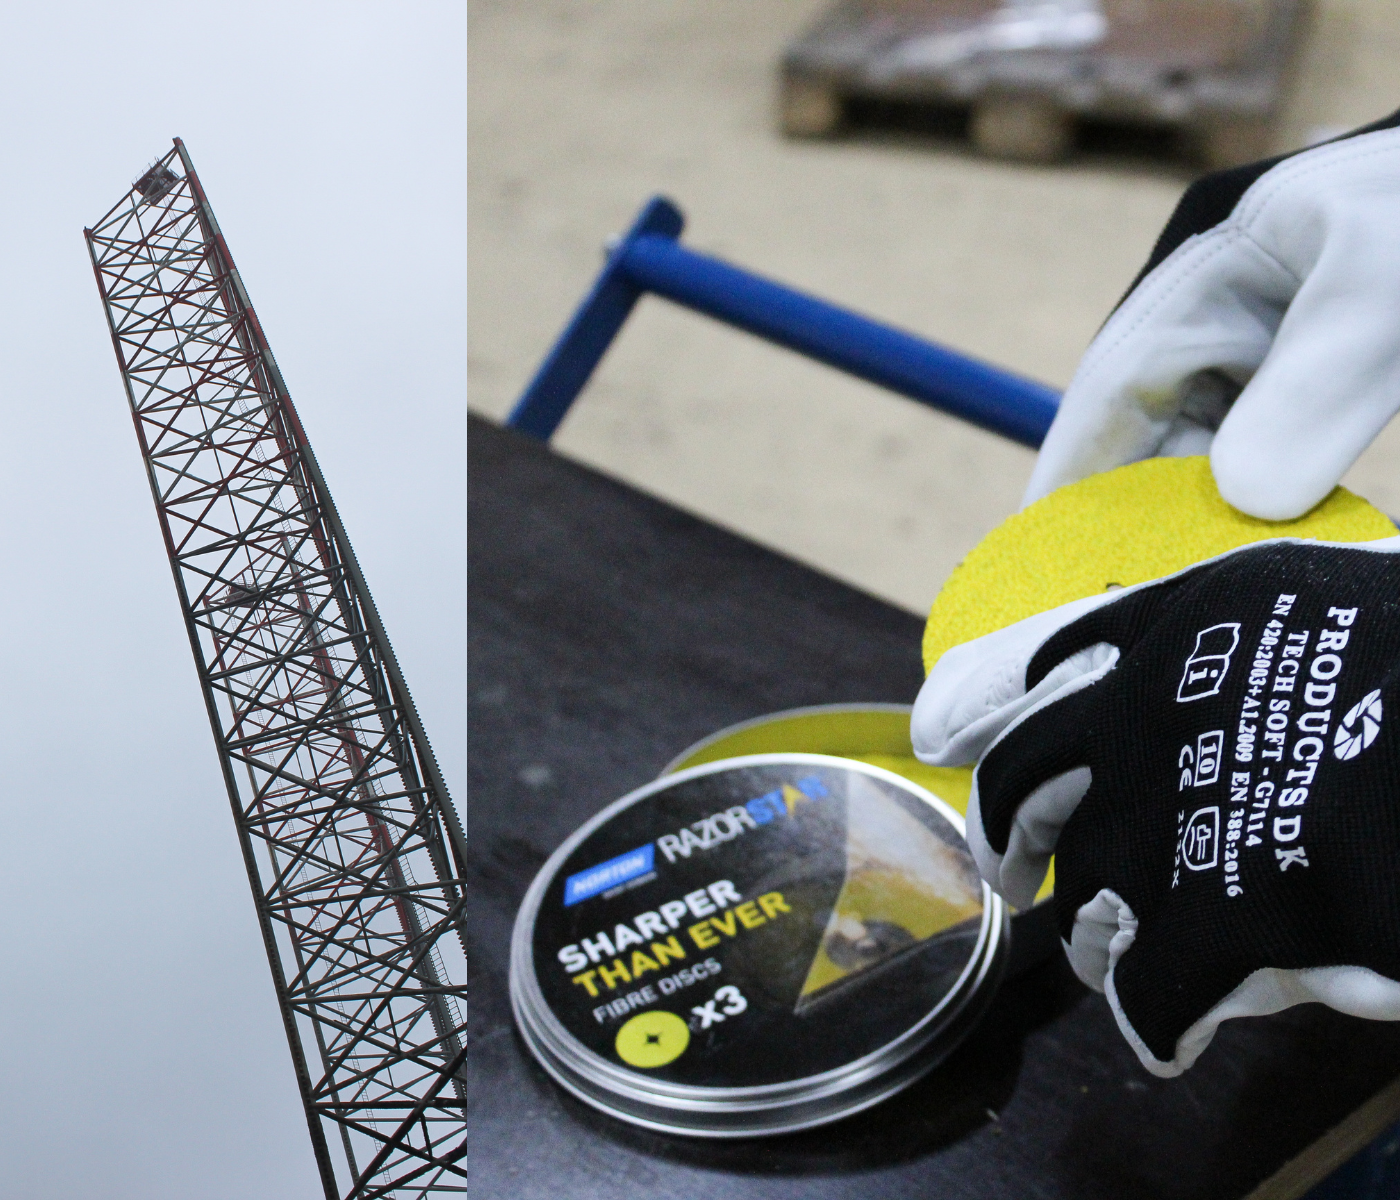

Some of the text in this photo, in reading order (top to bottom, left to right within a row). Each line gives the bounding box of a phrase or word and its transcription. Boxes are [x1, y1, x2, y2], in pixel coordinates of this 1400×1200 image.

[1273, 631, 1310, 693] TECH
[1200, 742, 1218, 775] 10
[1224, 593, 1297, 897] EN 420:2003+A1.2009 EN 388:2016
[1261, 699, 1291, 762] SOFT
[1273, 606, 1358, 872] PRODUCTS DK
[1245, 781, 1275, 847] G7114
[557, 879, 742, 973] SHARPER
[572, 891, 792, 997] THAN EVER
[592, 957, 722, 1024] FIBRE DISCS
[691, 985, 748, 1029] x3
